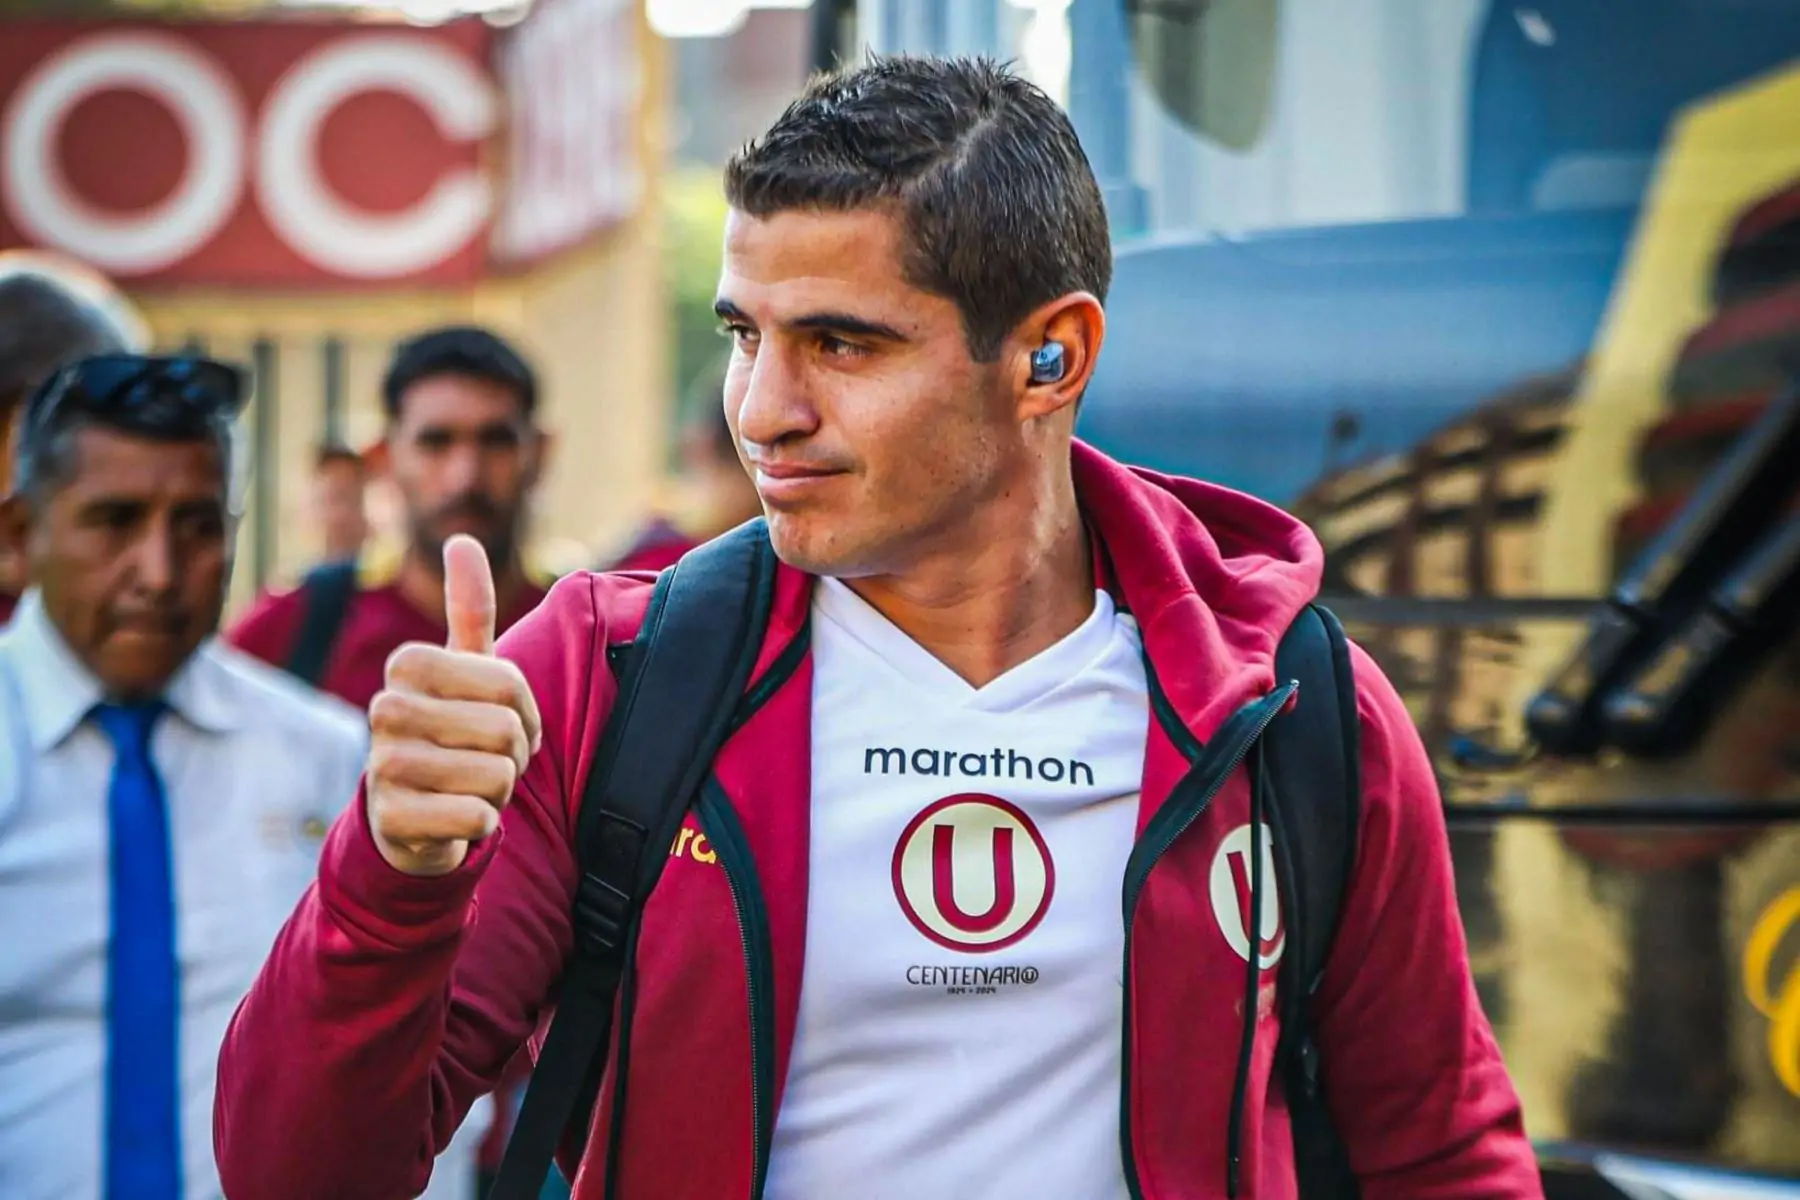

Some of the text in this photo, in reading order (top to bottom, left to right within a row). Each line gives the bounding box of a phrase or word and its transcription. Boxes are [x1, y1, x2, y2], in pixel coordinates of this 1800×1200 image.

[864, 747, 1094, 786] marathon
[932, 824, 1015, 934] U
[906, 965, 1040, 986] CENTENARIO
